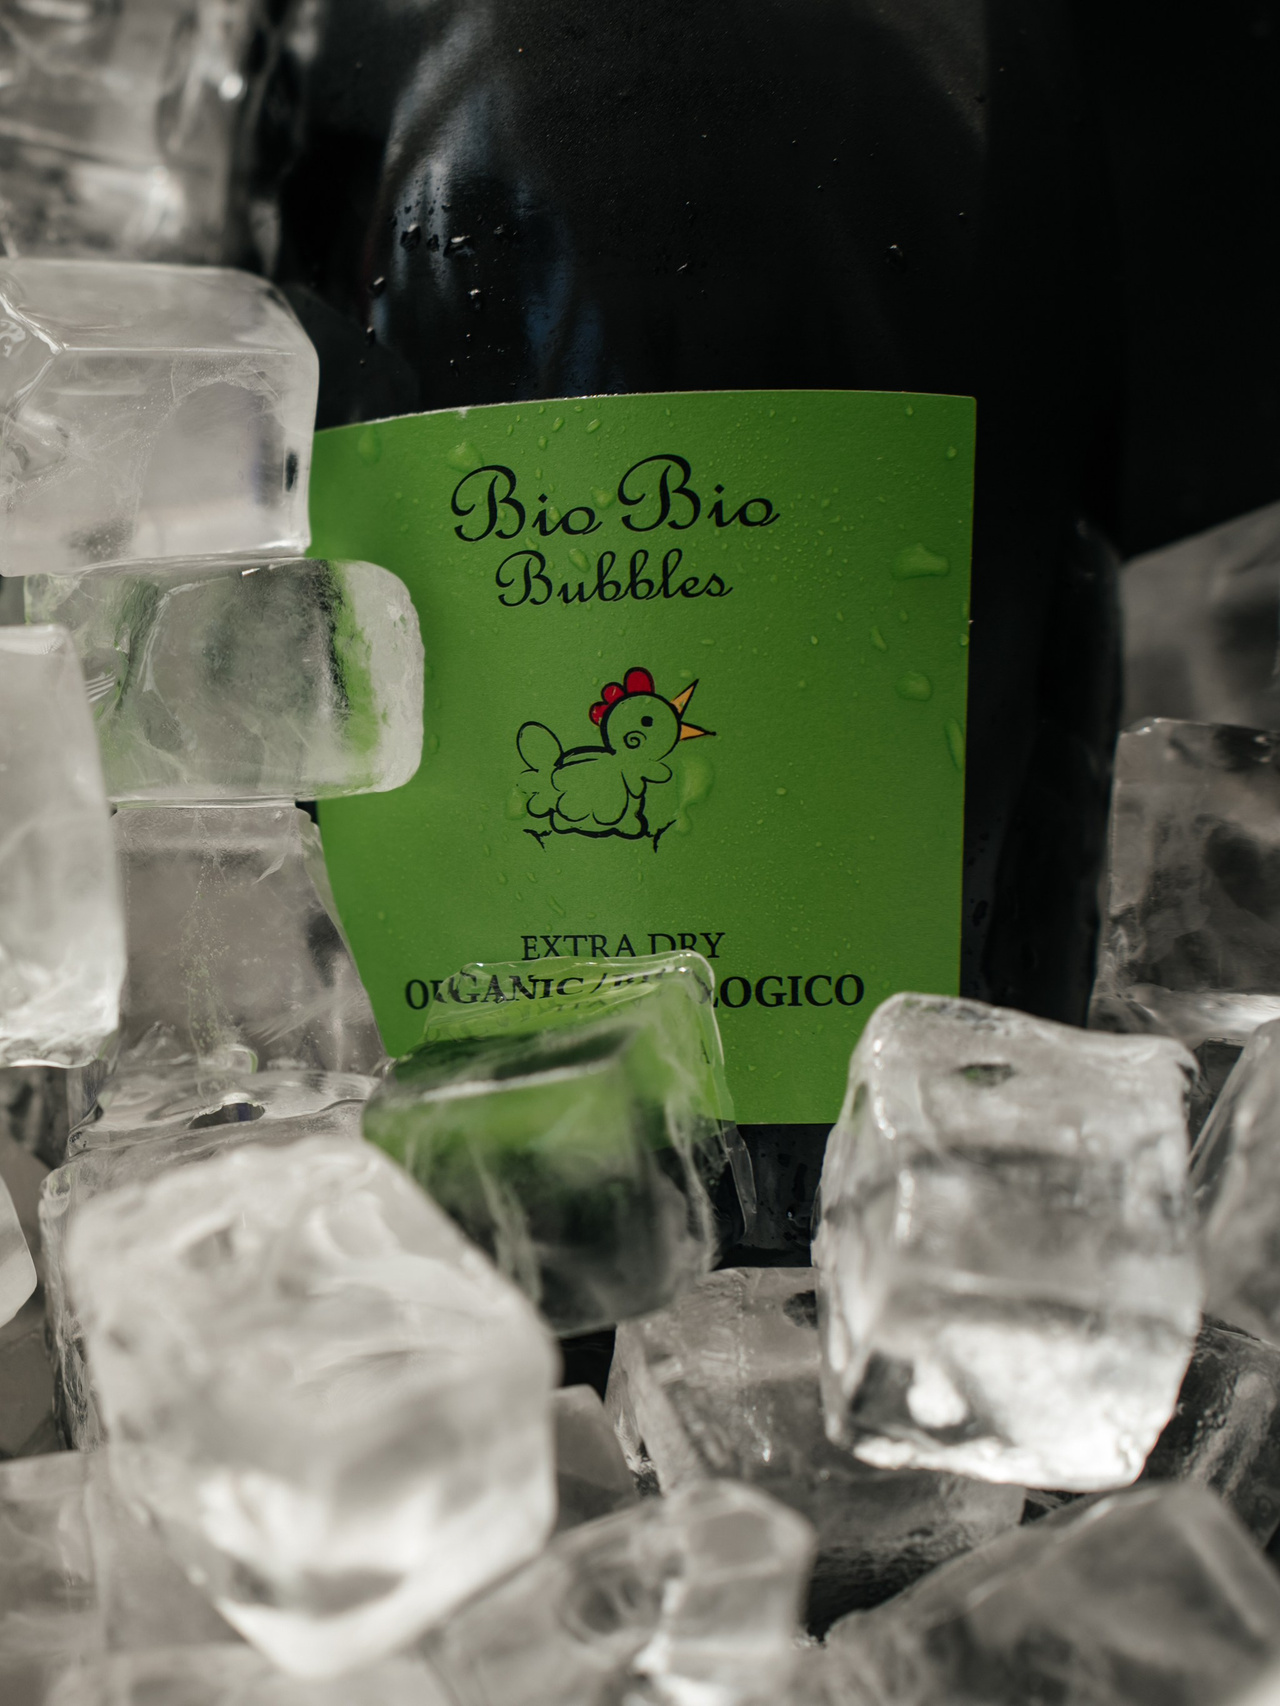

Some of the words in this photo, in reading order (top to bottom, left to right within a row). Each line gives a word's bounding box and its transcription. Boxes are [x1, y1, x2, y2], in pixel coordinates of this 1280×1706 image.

[451, 464, 603, 542] Bio
[617, 453, 781, 532] Bio
[495, 548, 733, 607] Bubbles
[521, 933, 637, 961] EXTRA
[647, 932, 725, 958] DRY
